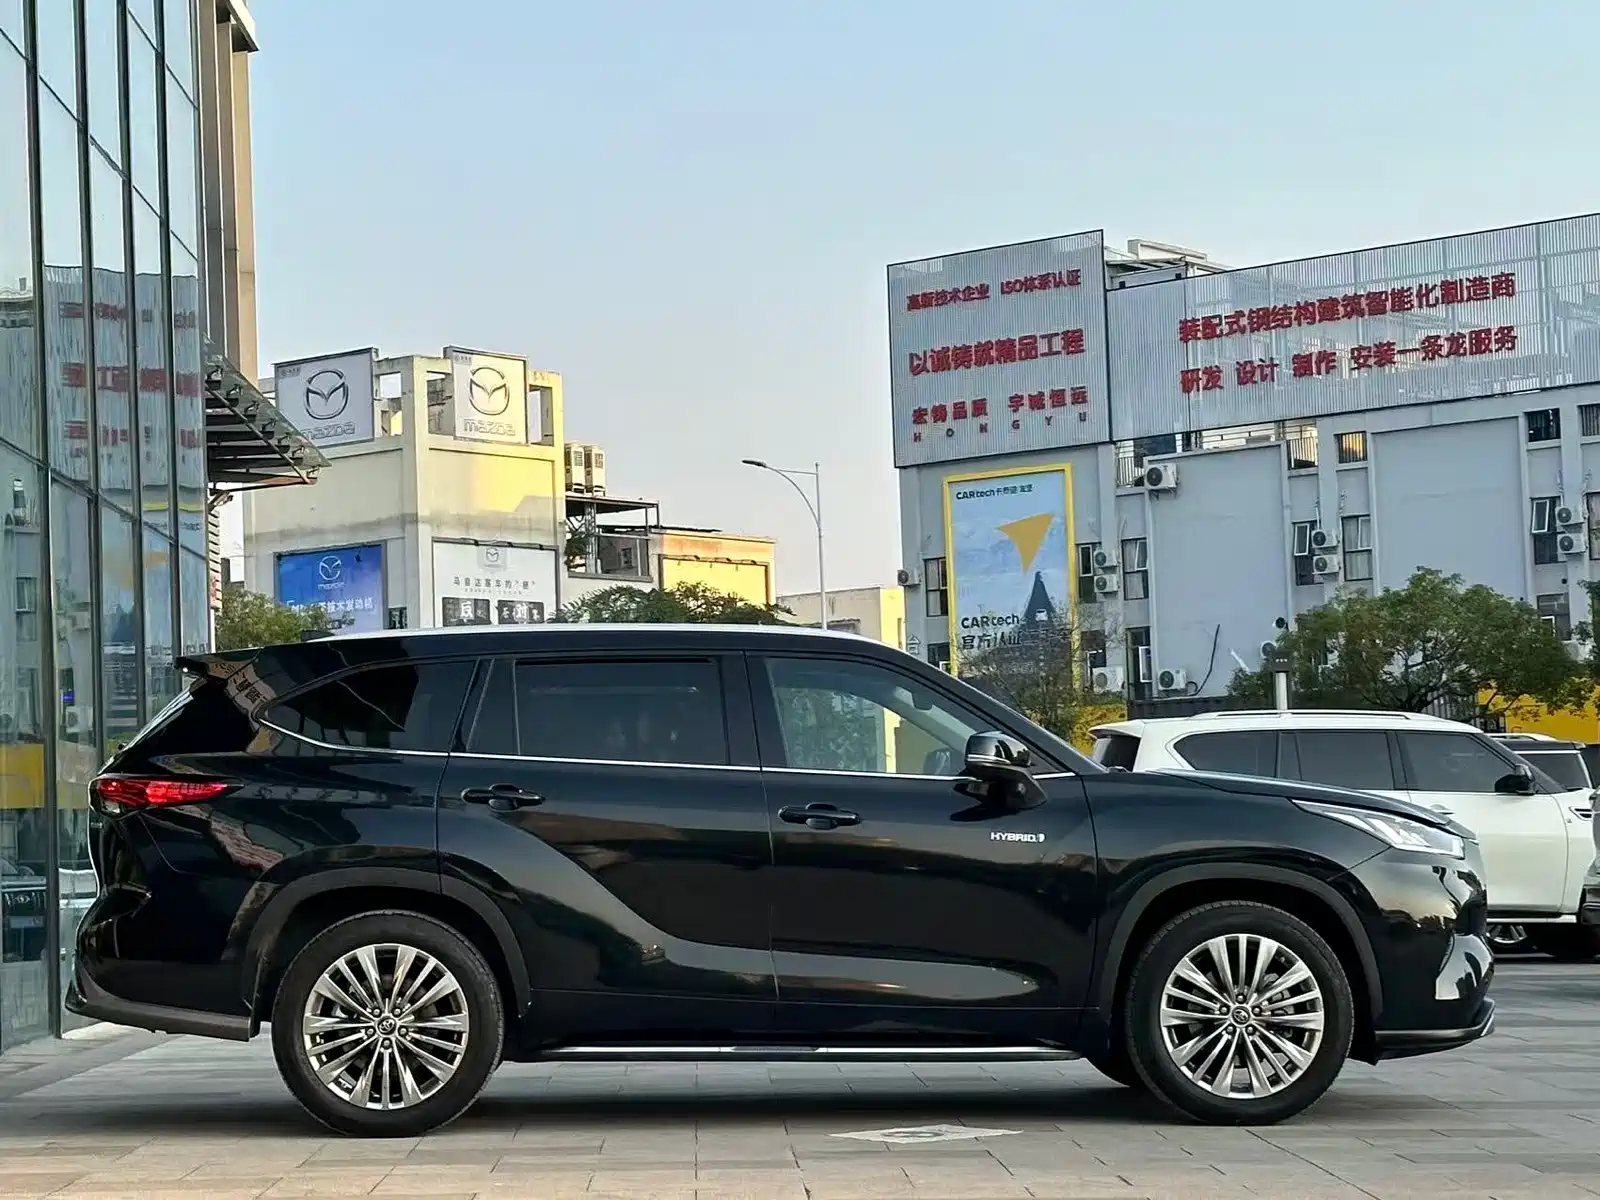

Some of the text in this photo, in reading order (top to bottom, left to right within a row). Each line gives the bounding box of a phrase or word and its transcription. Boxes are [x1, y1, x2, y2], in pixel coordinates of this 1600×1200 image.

[1178, 271, 1517, 344] 装配式钢结构建筑智能化制造商
[1180, 365, 1224, 394] 研发
[1236, 357, 1280, 386] 设计
[1350, 325, 1518, 371] 安装一条龙服务
[463, 418, 516, 437] mazda
[961, 614, 1020, 629] CARtech
[990, 831, 1038, 843] HYBRID
